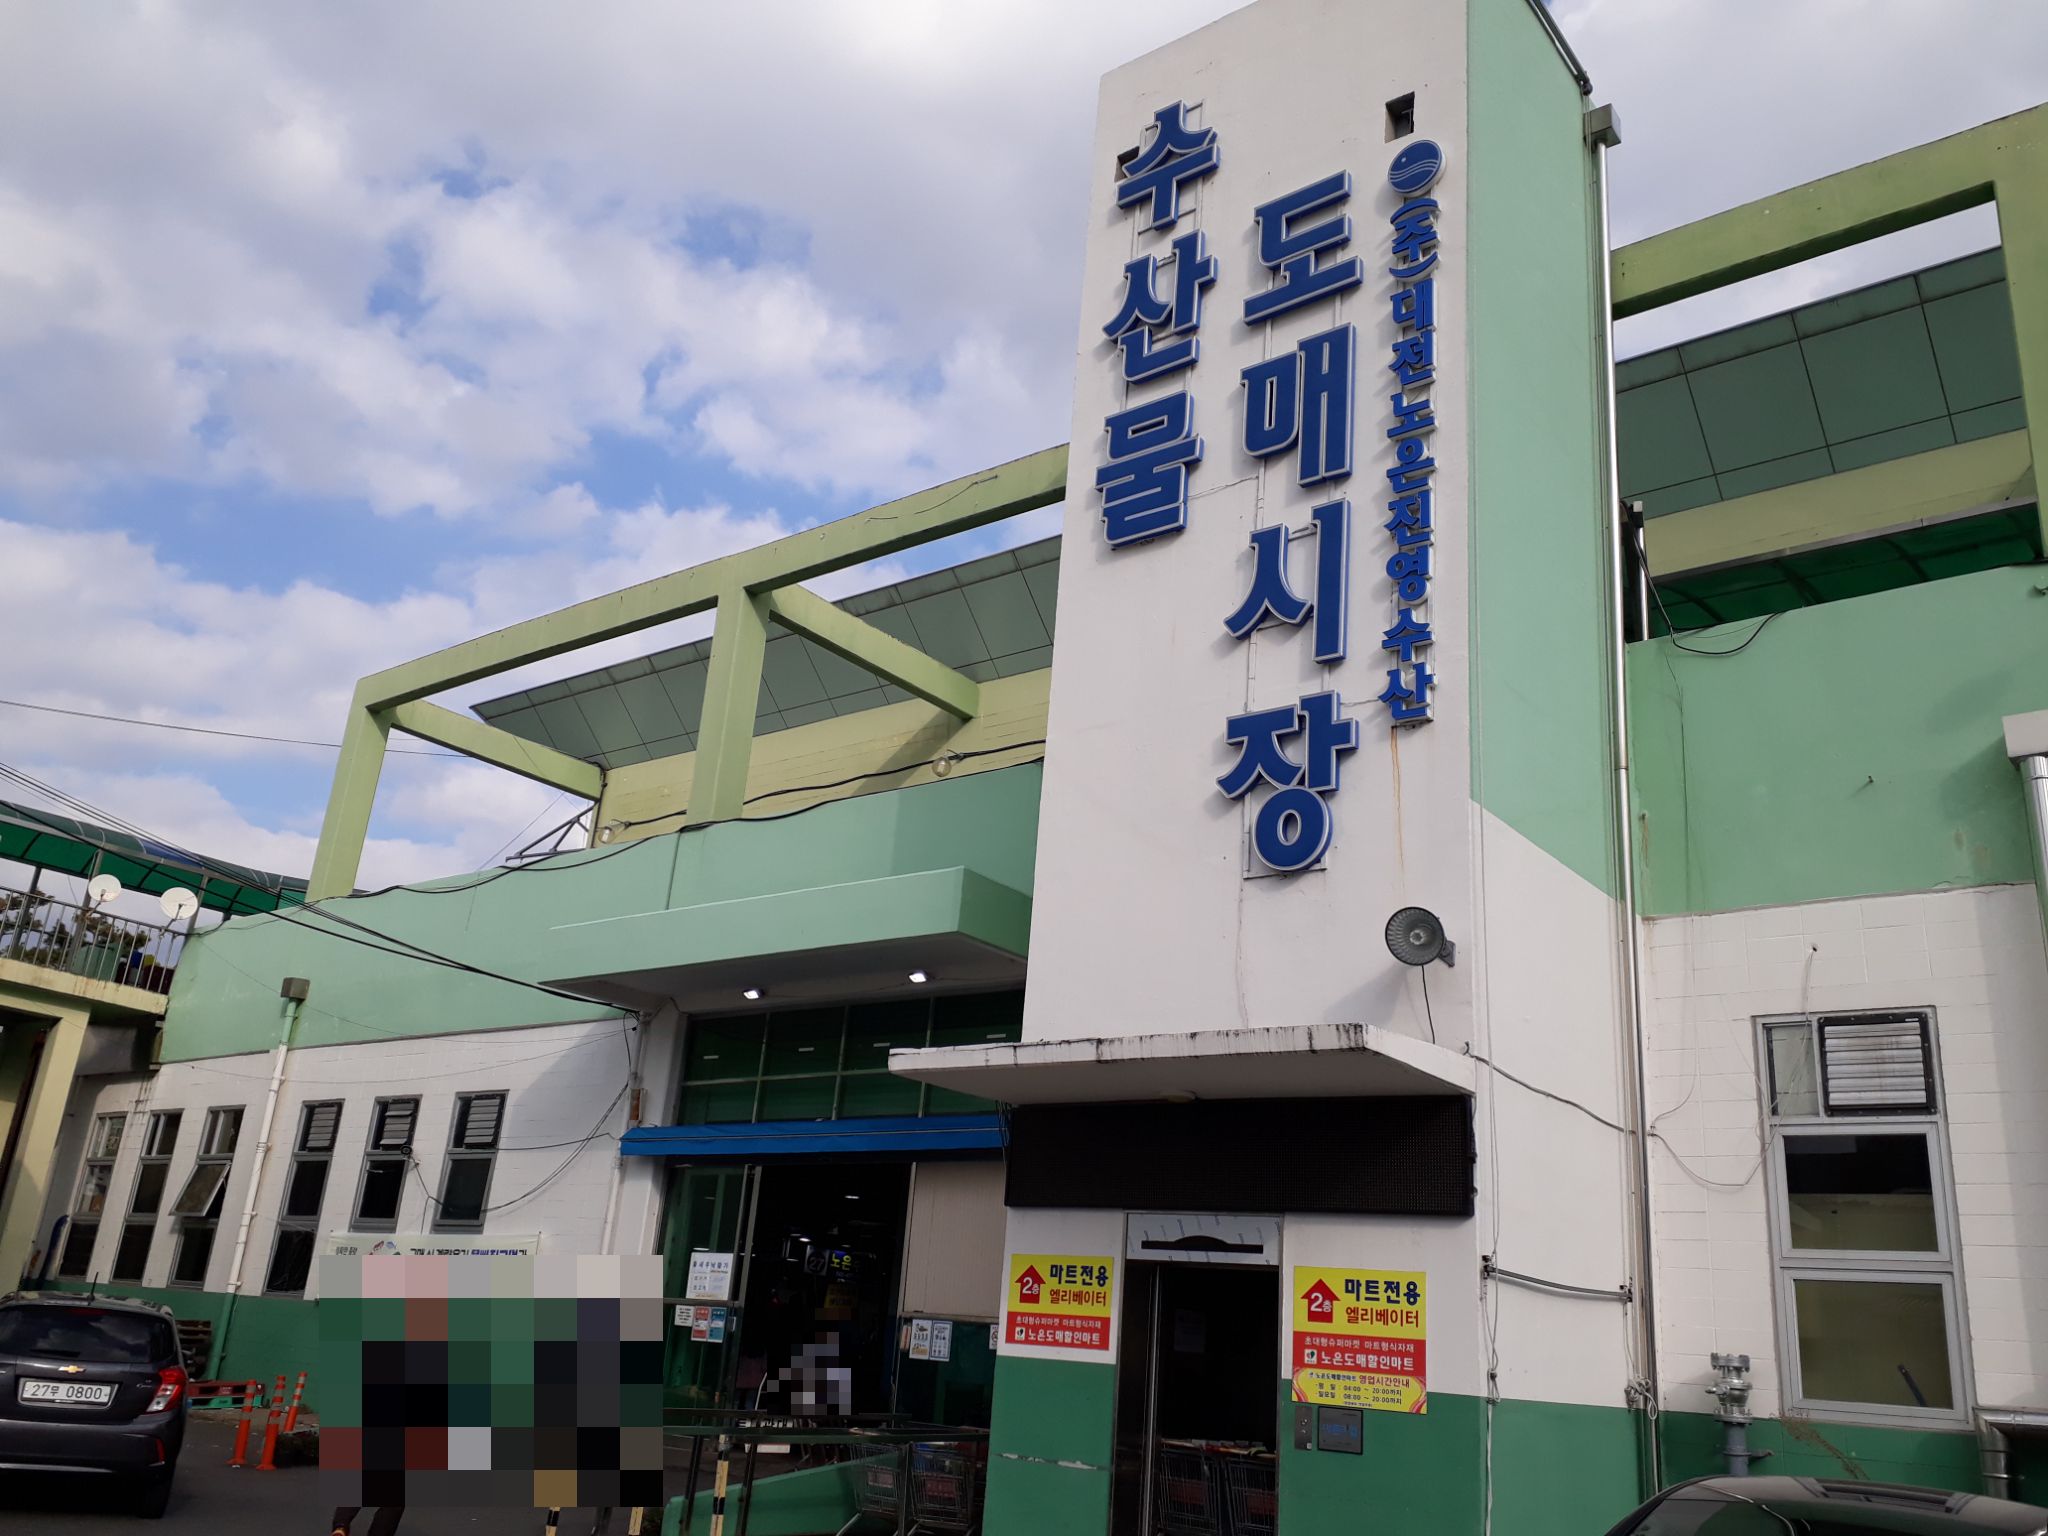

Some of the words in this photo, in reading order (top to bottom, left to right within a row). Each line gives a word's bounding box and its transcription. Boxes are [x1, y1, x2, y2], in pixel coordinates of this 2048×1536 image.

[1096, 100, 1220, 548] 수산물
[1216, 169, 1363, 872] 도매시장
[1022, 1276, 1040, 1295] 2층
[1049, 1264, 1109, 1288] 마트전용
[1049, 1288, 1107, 1307] 엘리베이터
[1344, 1278, 1421, 1306] 마트전용
[1310, 1292, 1332, 1313] 2층
[1345, 1306, 1419, 1328] 엘리베이터
[1027, 1328, 1100, 1345] 노은도매할인마트
[1304, 1336, 1360, 1349] 초대형슈퍼마켓
[1364, 1341, 1414, 1353] 마트형식자재
[1321, 1351, 1414, 1371] 노은도매할인마트
[1358, 1374, 1410, 1389] 영업시간안내
[65, 1385, 103, 1400] 0800
